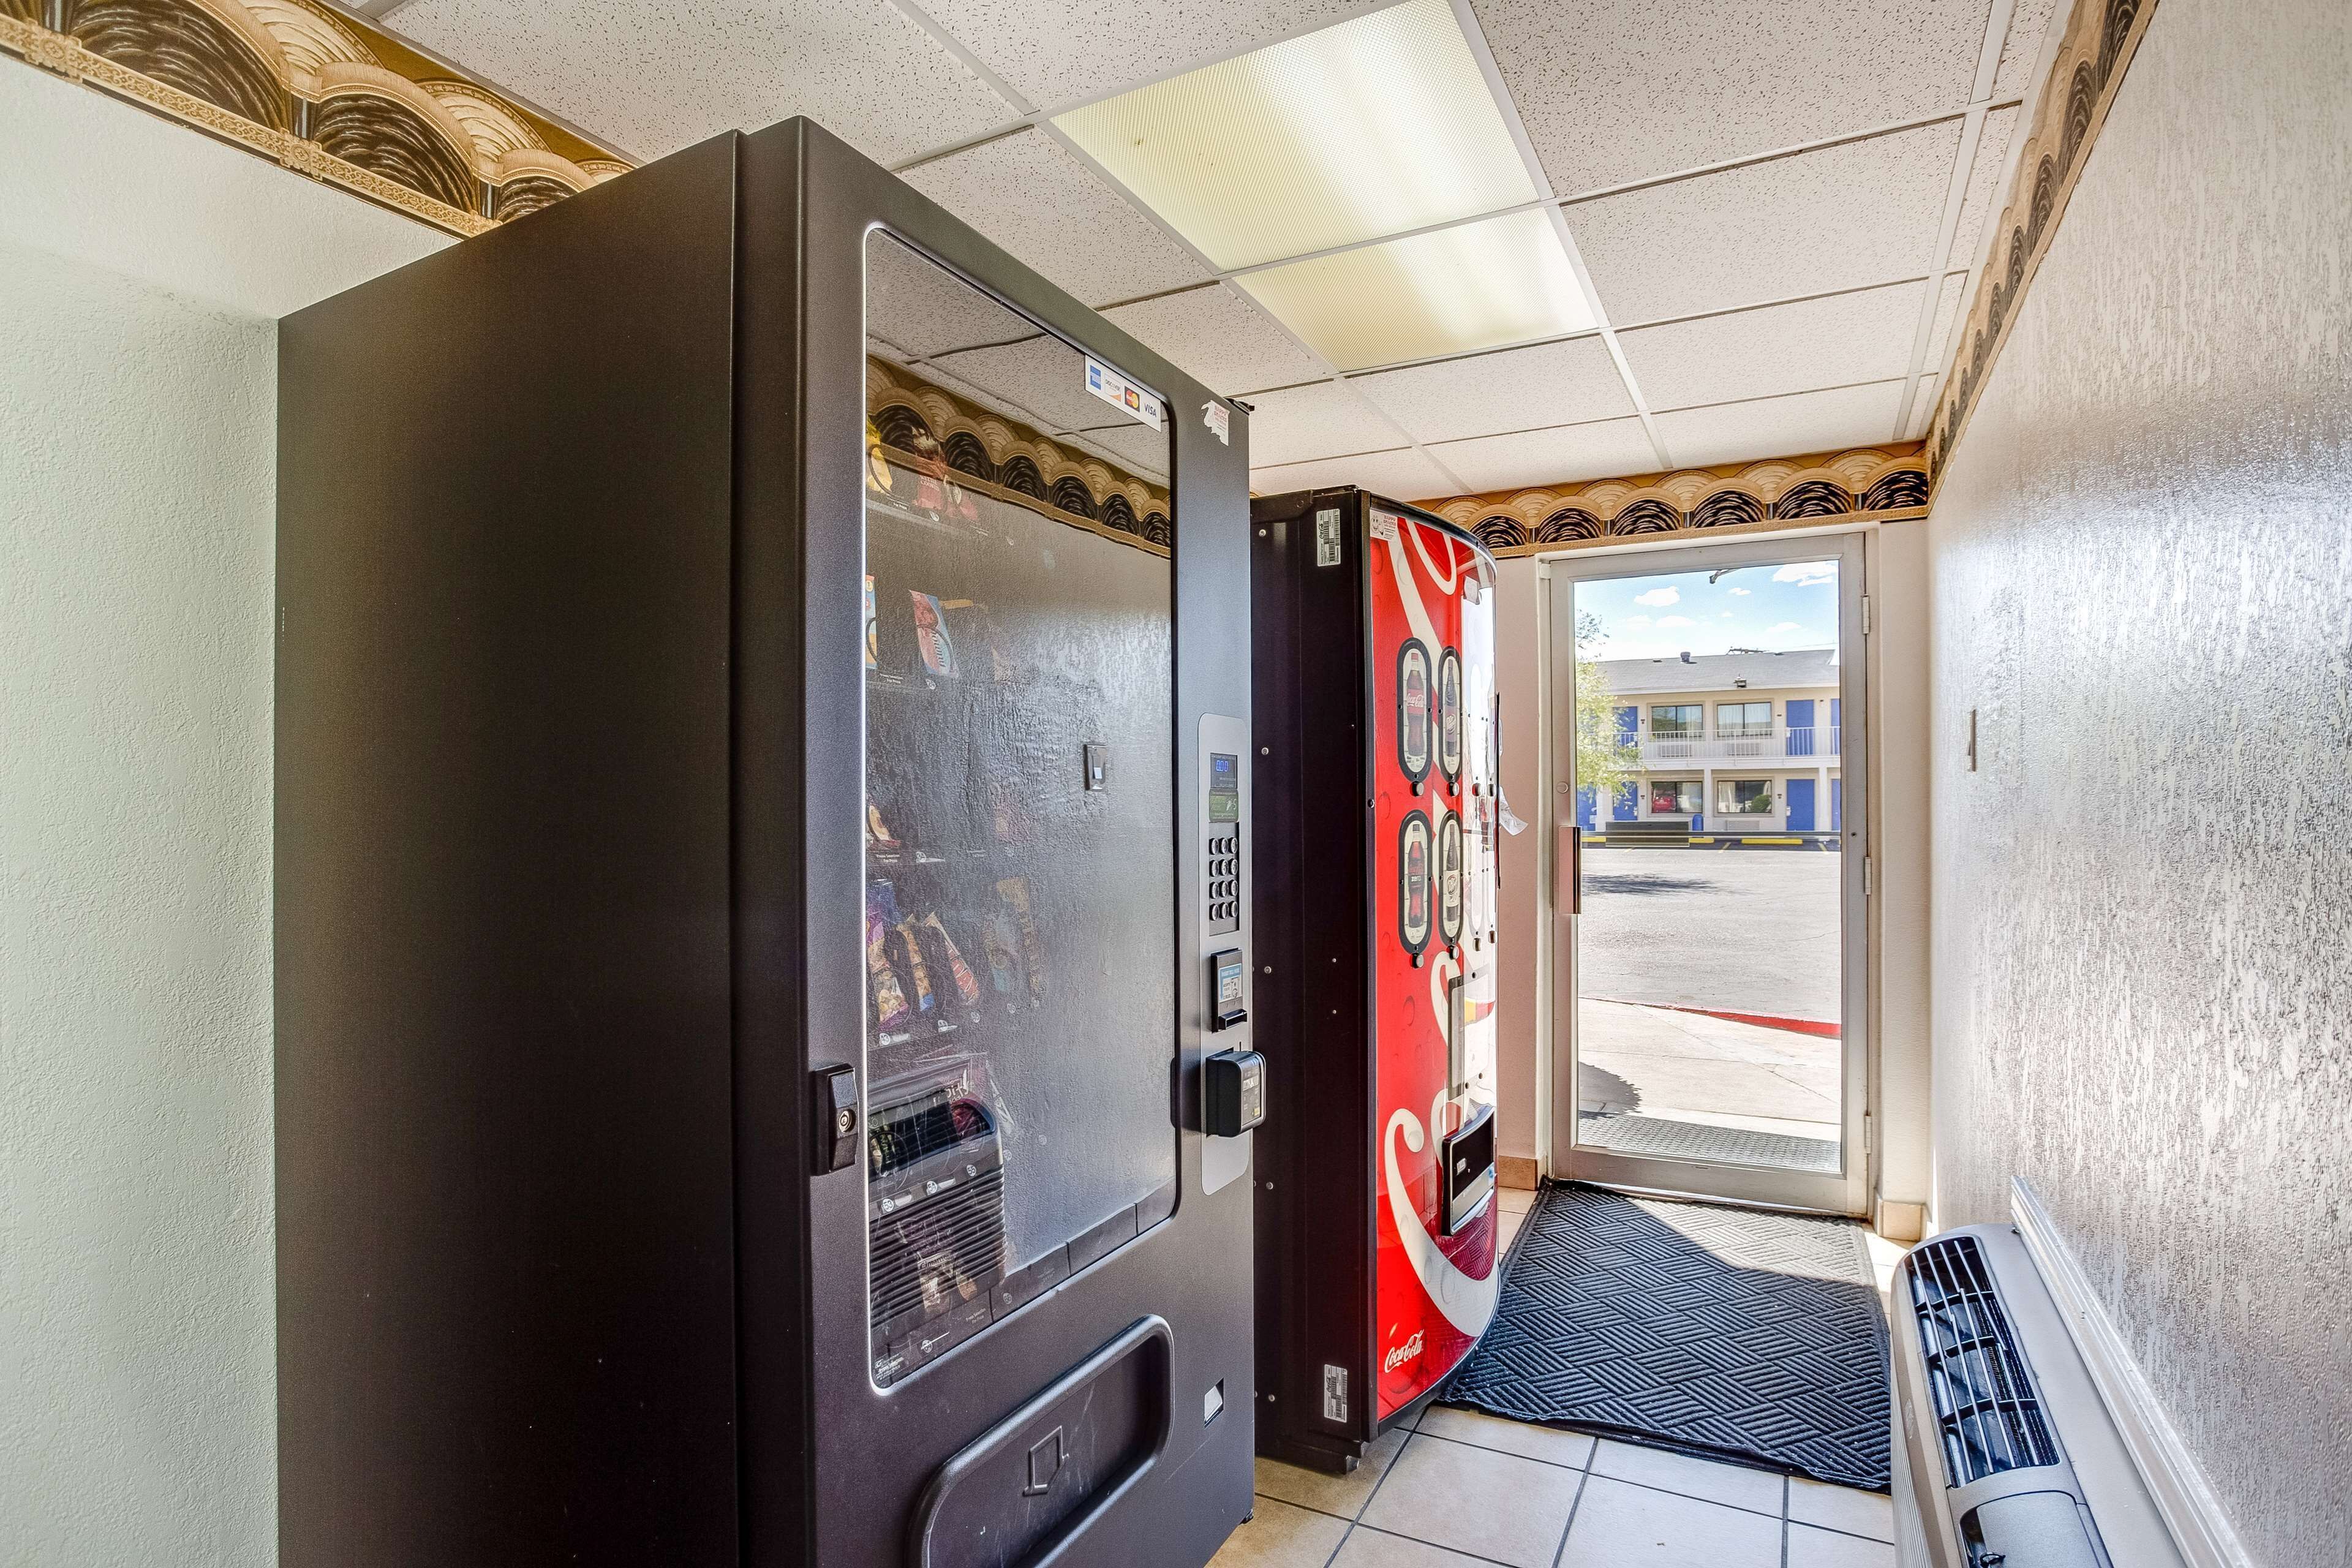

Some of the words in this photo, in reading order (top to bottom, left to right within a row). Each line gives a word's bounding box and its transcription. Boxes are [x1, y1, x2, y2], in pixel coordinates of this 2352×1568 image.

[1144, 403, 1157, 418] VISA
[967, 1165, 975, 1175] 55
[883, 1200, 892, 1209] 53
[1384, 1329, 1425, 1373] Coca-Cola
